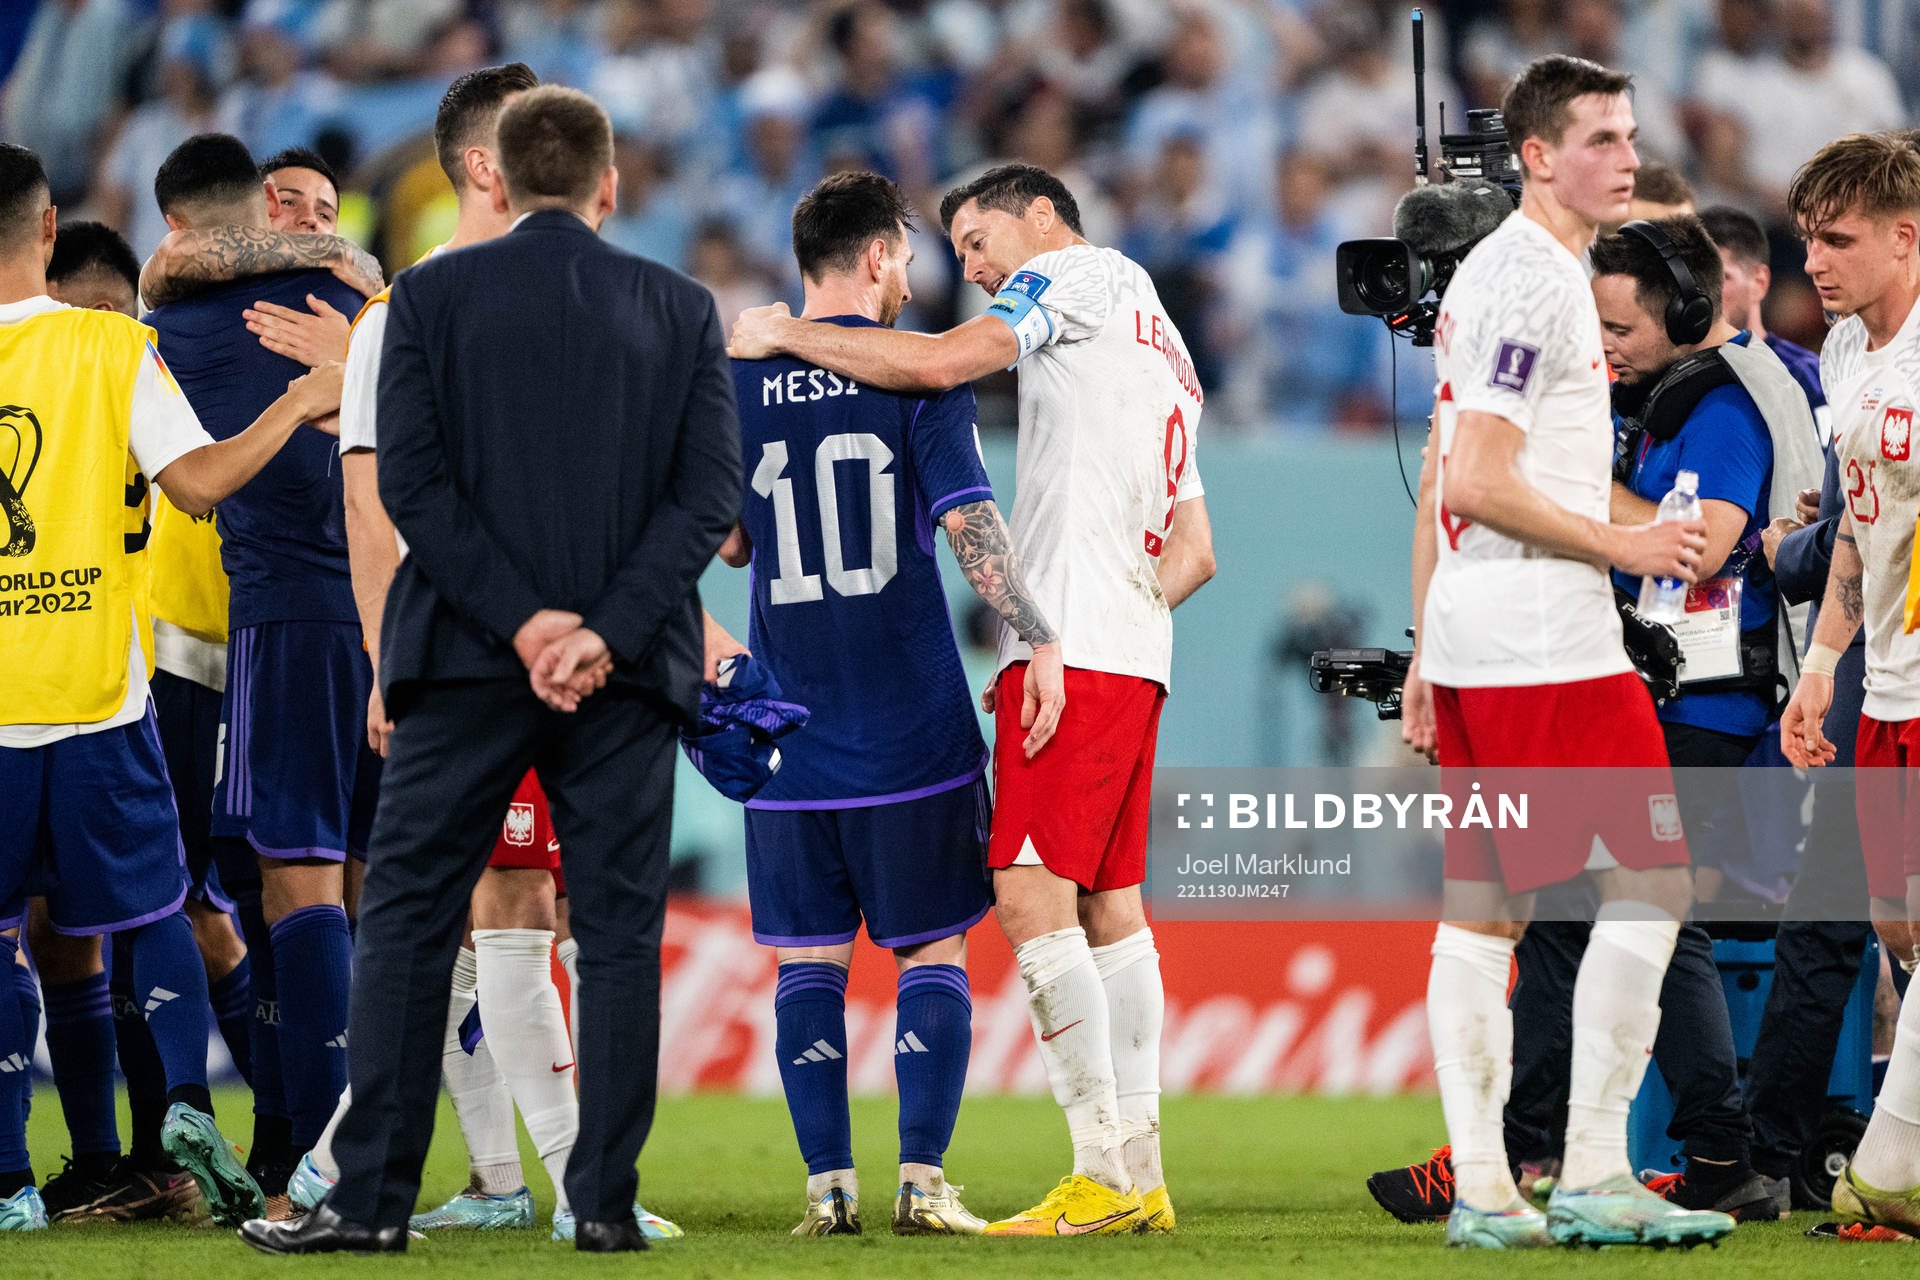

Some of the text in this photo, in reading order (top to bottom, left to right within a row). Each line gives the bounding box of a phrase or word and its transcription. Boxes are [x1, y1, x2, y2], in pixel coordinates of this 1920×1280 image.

[751, 432, 898, 605] 10
[0, 567, 102, 592] ORLD CUP
[0, 590, 92, 616] ar2022
